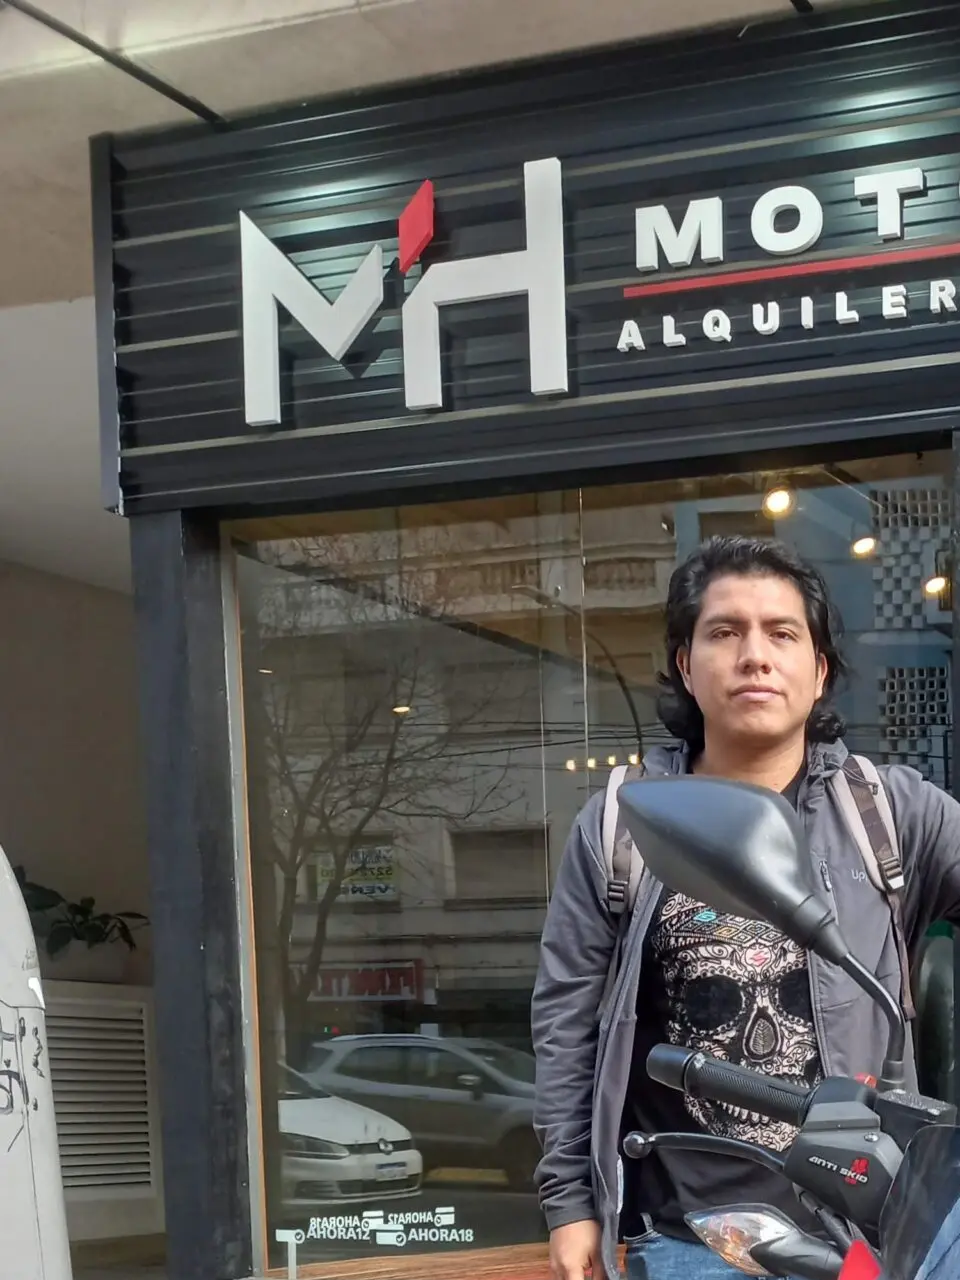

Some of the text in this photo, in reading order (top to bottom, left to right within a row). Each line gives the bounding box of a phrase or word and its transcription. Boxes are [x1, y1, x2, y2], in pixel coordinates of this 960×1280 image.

[616, 279, 957, 353] ALQUILER
[808, 1155, 868, 1184] ANTI SKID
[306, 1224, 474, 1242] AHORA12 AHORA18
